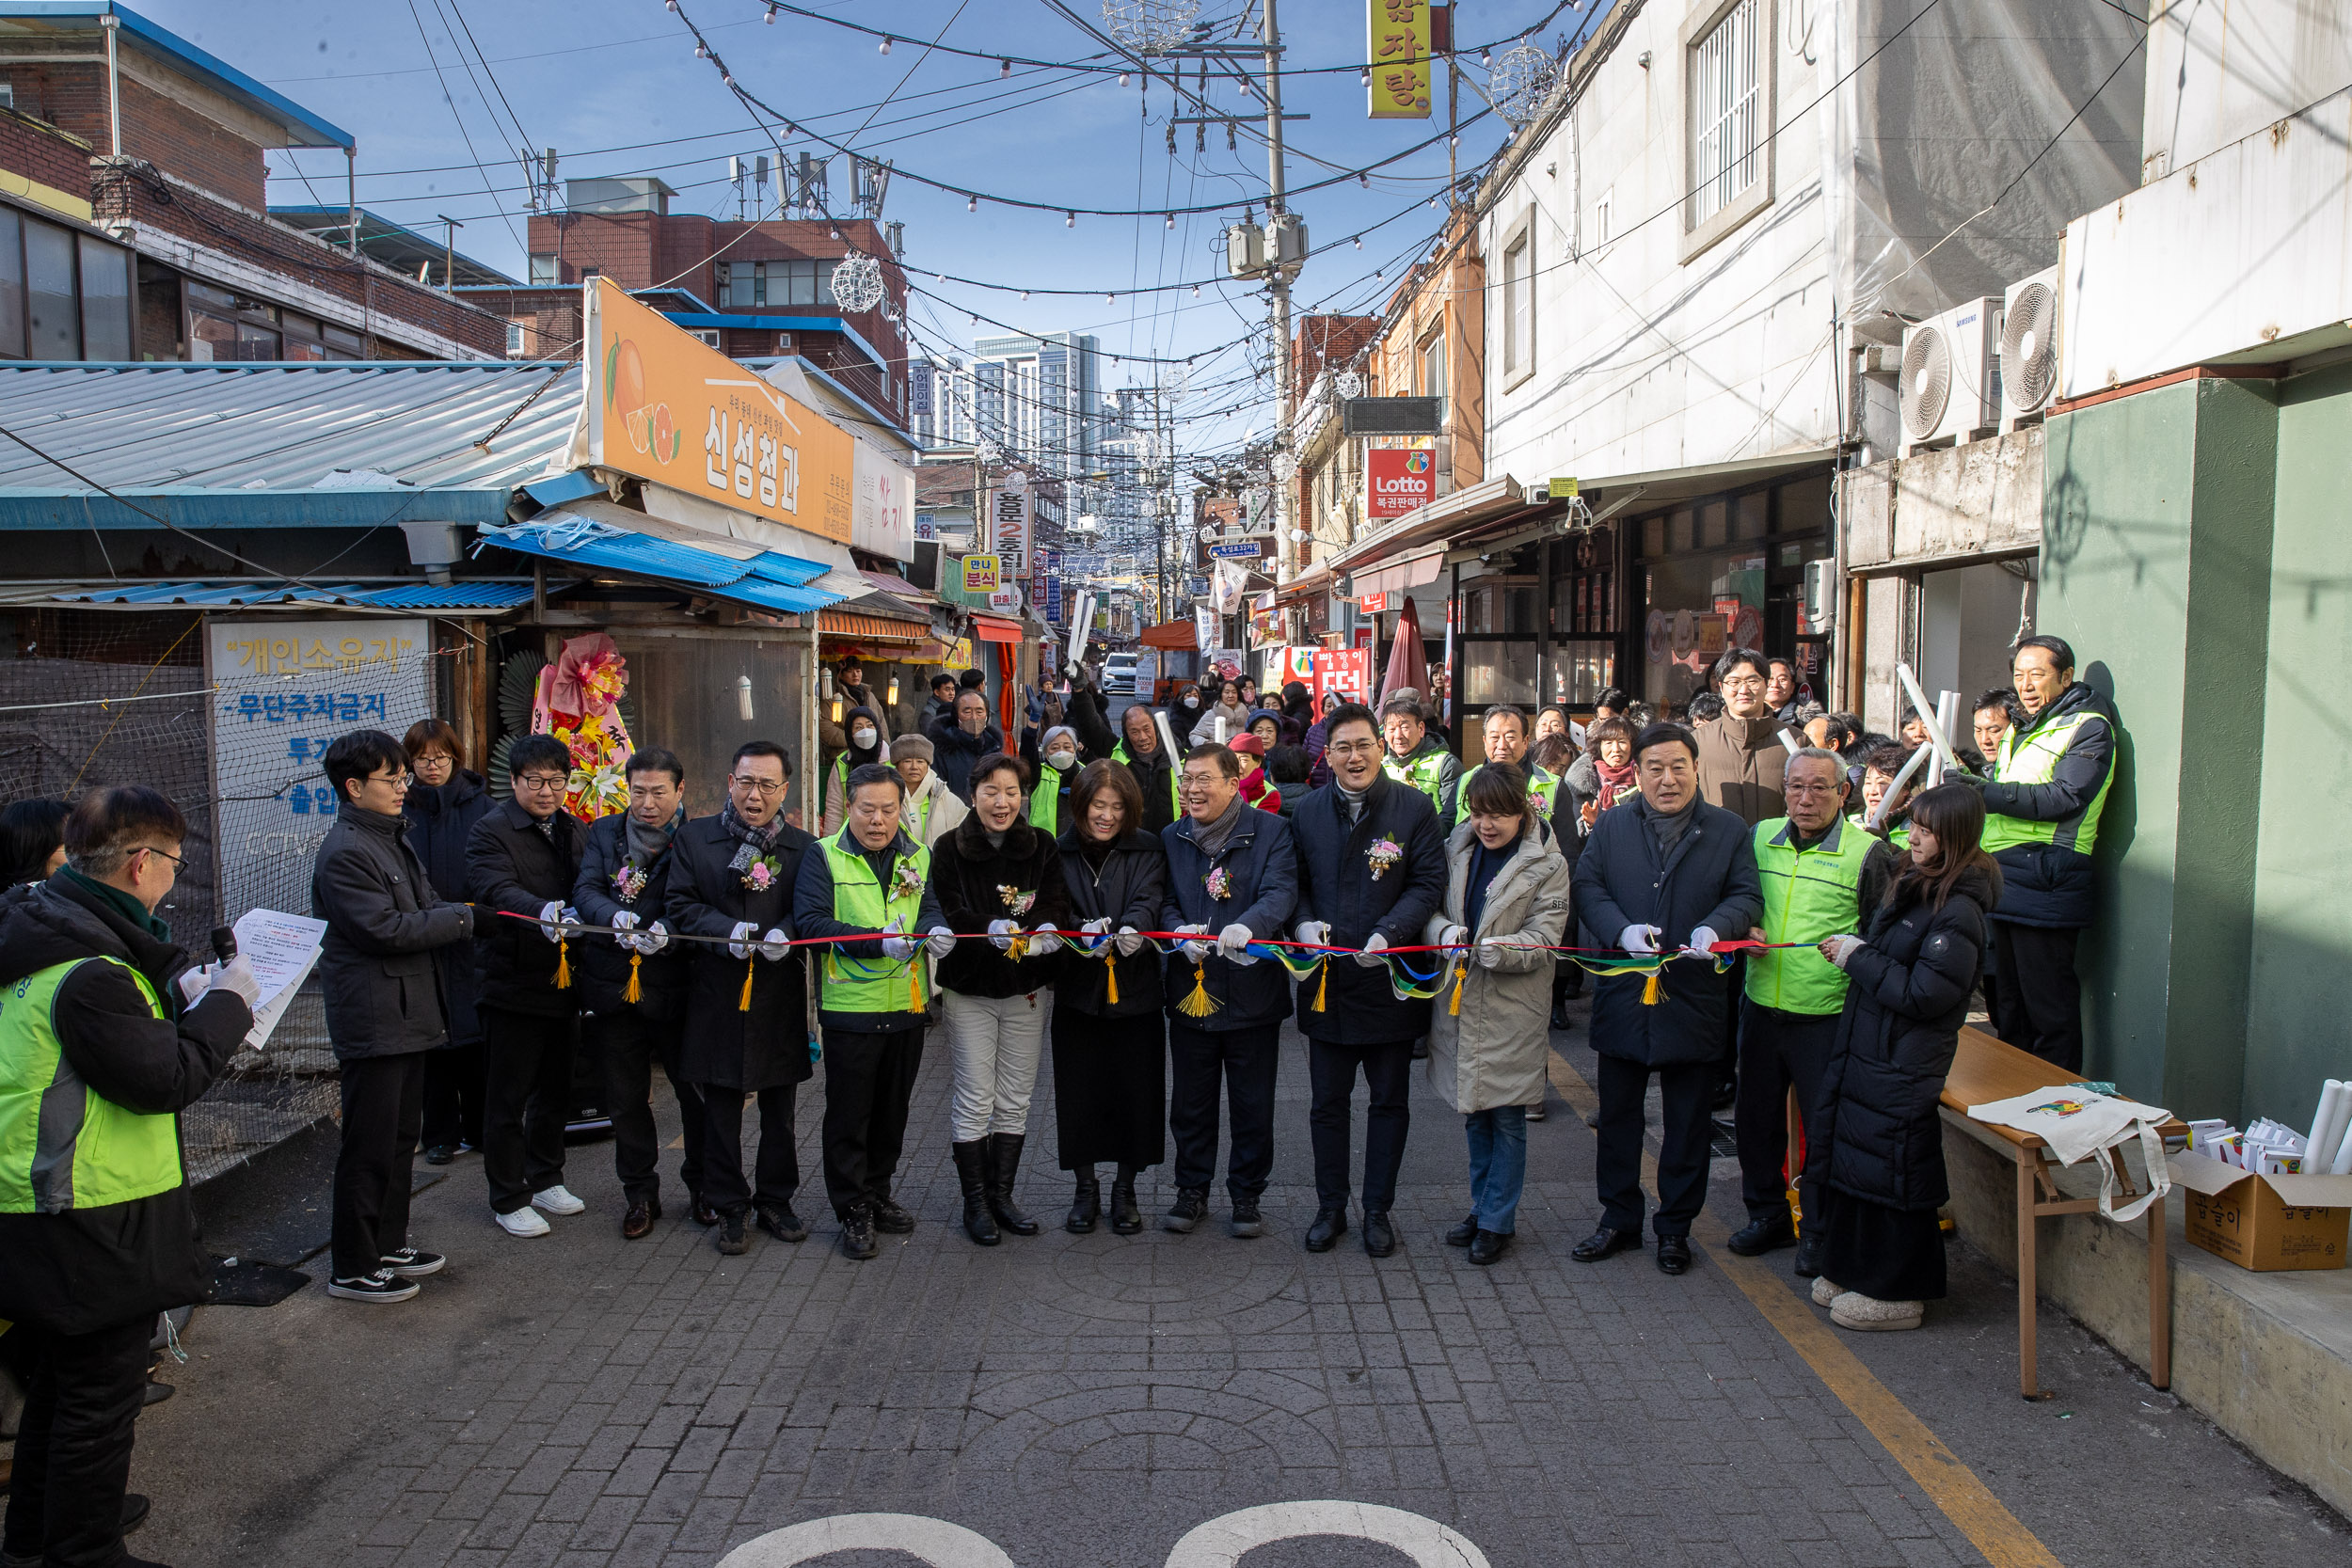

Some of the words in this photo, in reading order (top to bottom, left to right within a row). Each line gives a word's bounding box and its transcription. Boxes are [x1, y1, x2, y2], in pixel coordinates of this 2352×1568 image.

[1956, 313, 1977, 327] SAMSUNG
[916, 374, 928, 410] 어린이집
[705, 405, 800, 516] 신성청과
[1376, 476, 1427, 493] Lotto
[1376, 497, 1427, 509] 복권판매점
[970, 560, 992, 570] 만나
[966, 572, 995, 588] 분식
